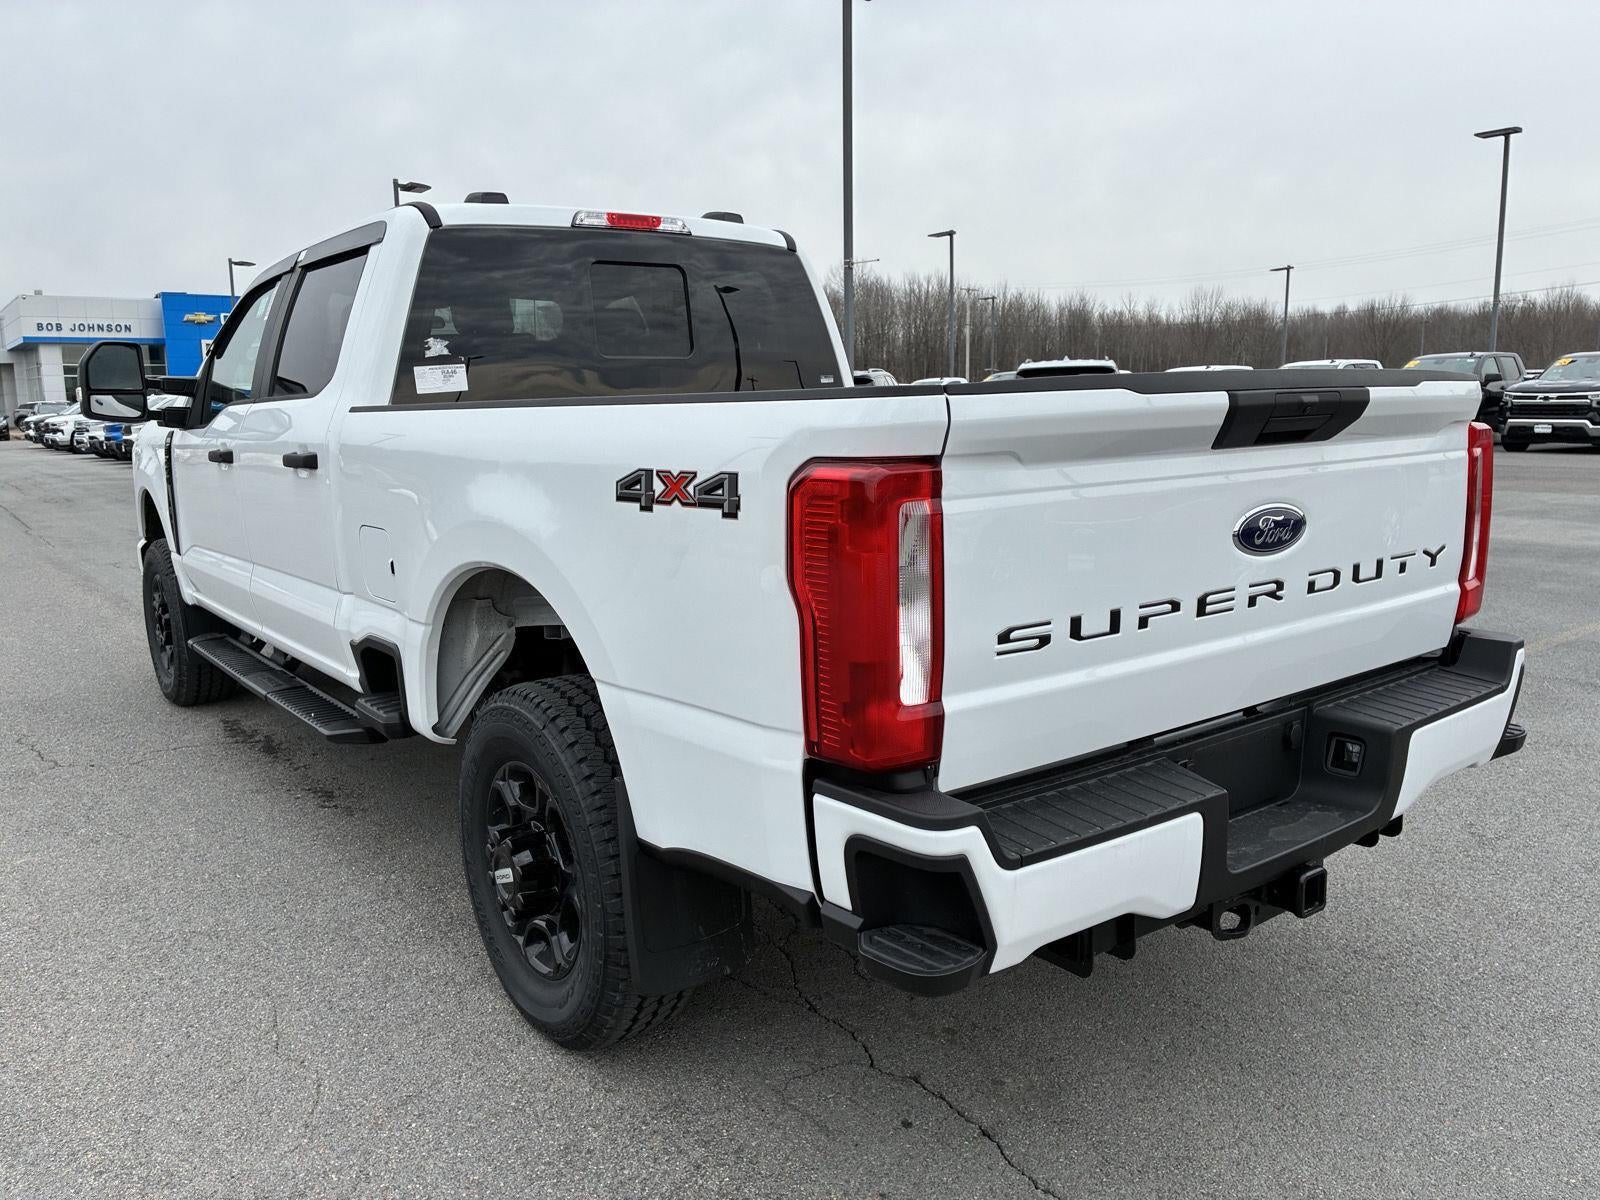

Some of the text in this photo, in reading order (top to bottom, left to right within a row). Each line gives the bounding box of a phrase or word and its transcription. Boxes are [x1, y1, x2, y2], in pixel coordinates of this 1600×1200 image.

[36, 322, 132, 333] BOB JOHNSON
[1254, 515, 1294, 545] Ford
[996, 544, 1446, 656] SUPER DUTY
